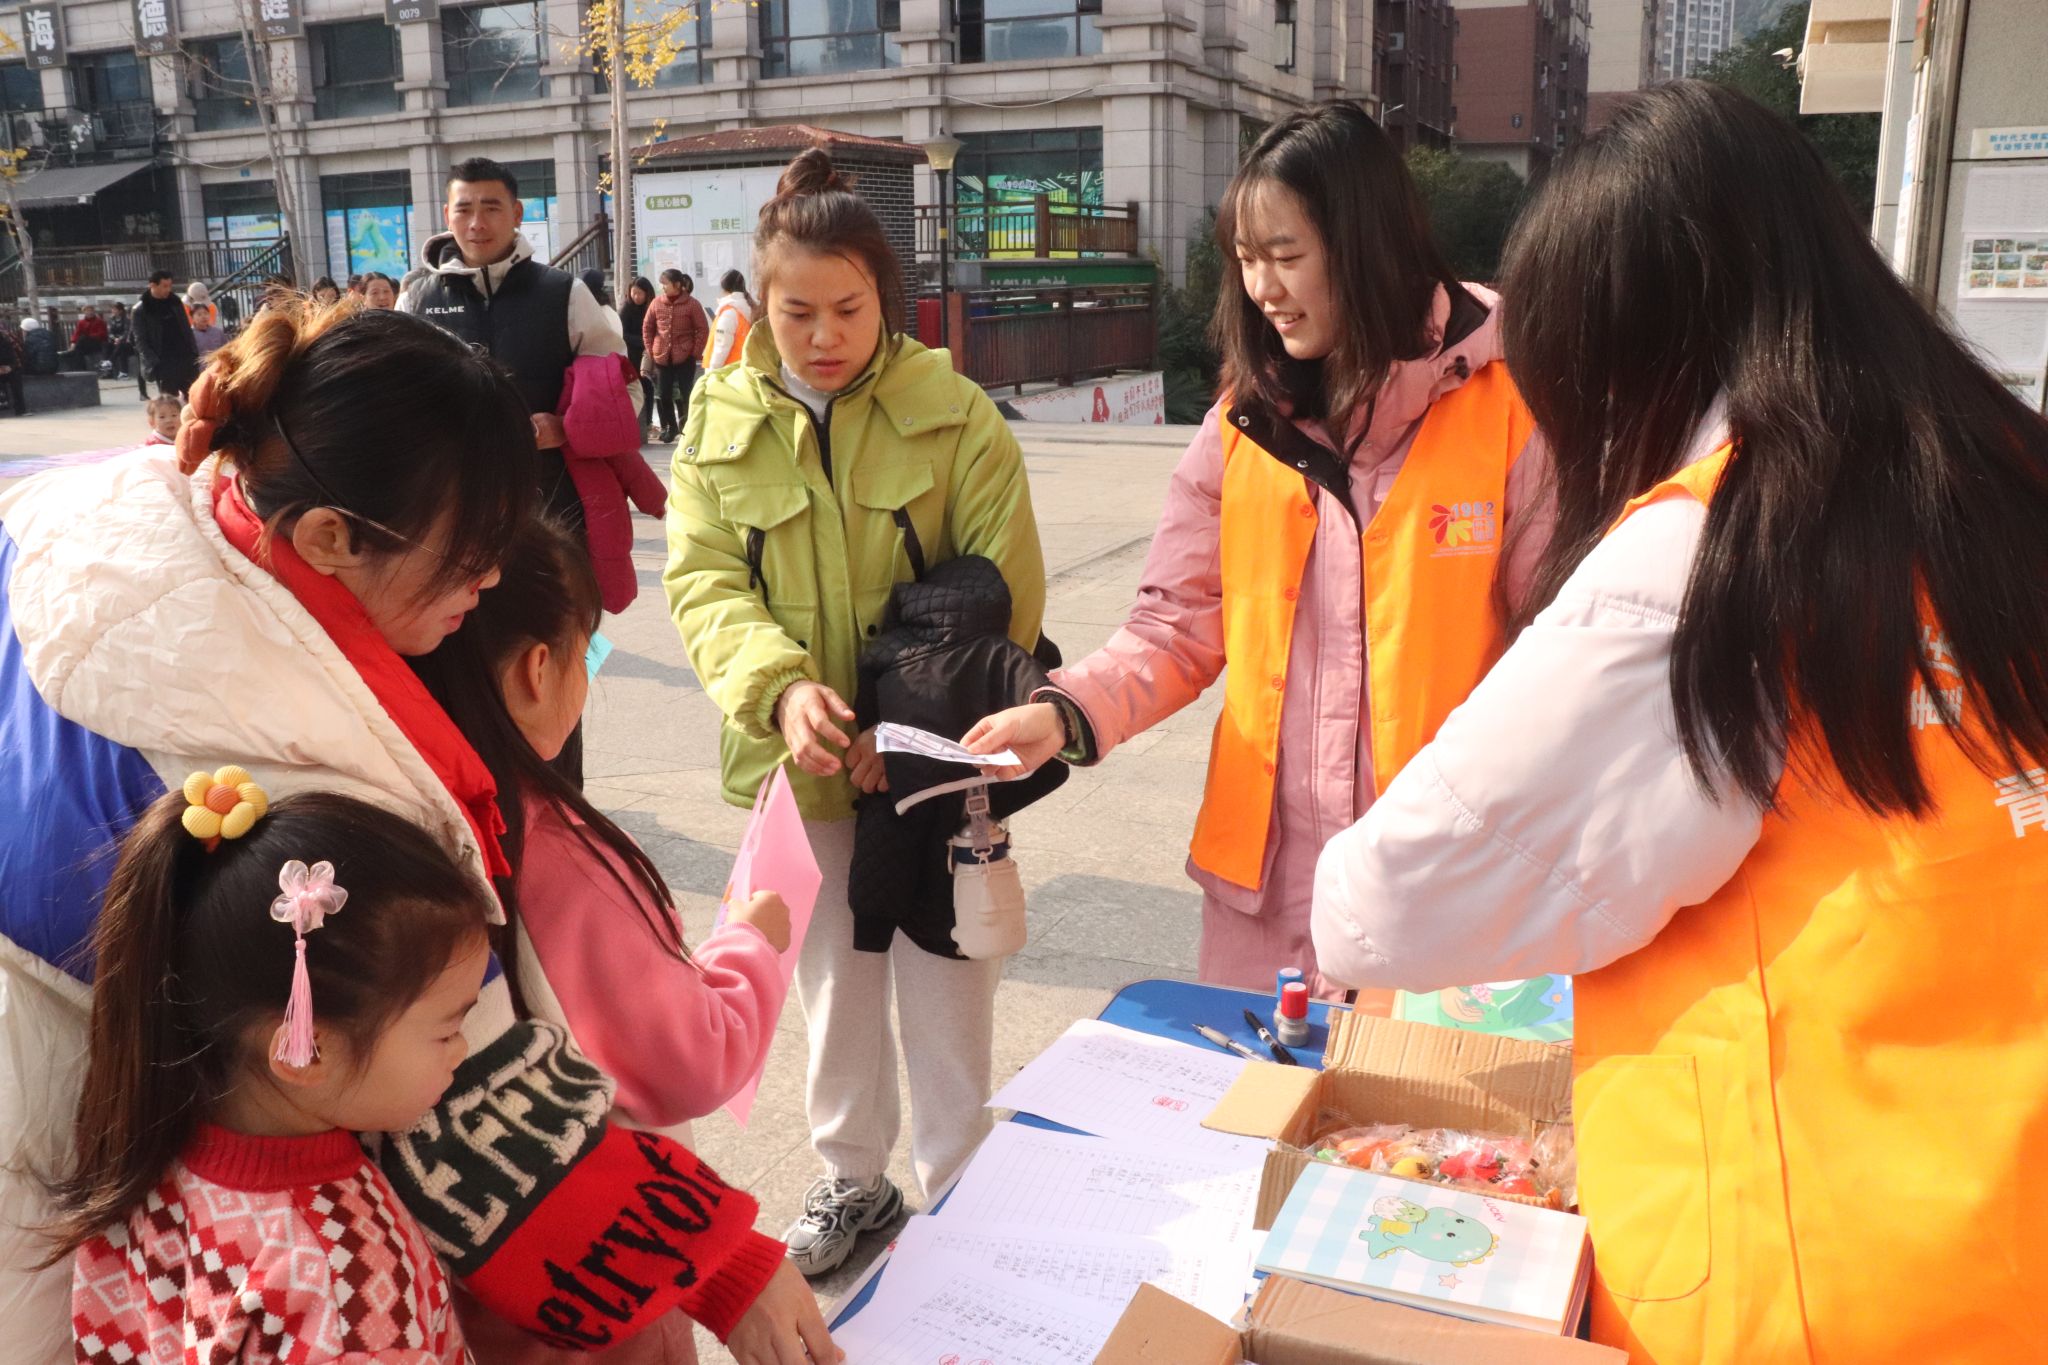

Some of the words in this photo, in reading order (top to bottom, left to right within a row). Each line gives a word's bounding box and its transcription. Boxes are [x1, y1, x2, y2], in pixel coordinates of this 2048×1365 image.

[399, 8, 420, 20] 0079
[25, 9, 55, 52] 海
[138, 0, 168, 39] 德
[656, 197, 689, 208] 当心触电
[710, 218, 741, 230] 宣传栏
[425, 305, 465, 315] KELME
